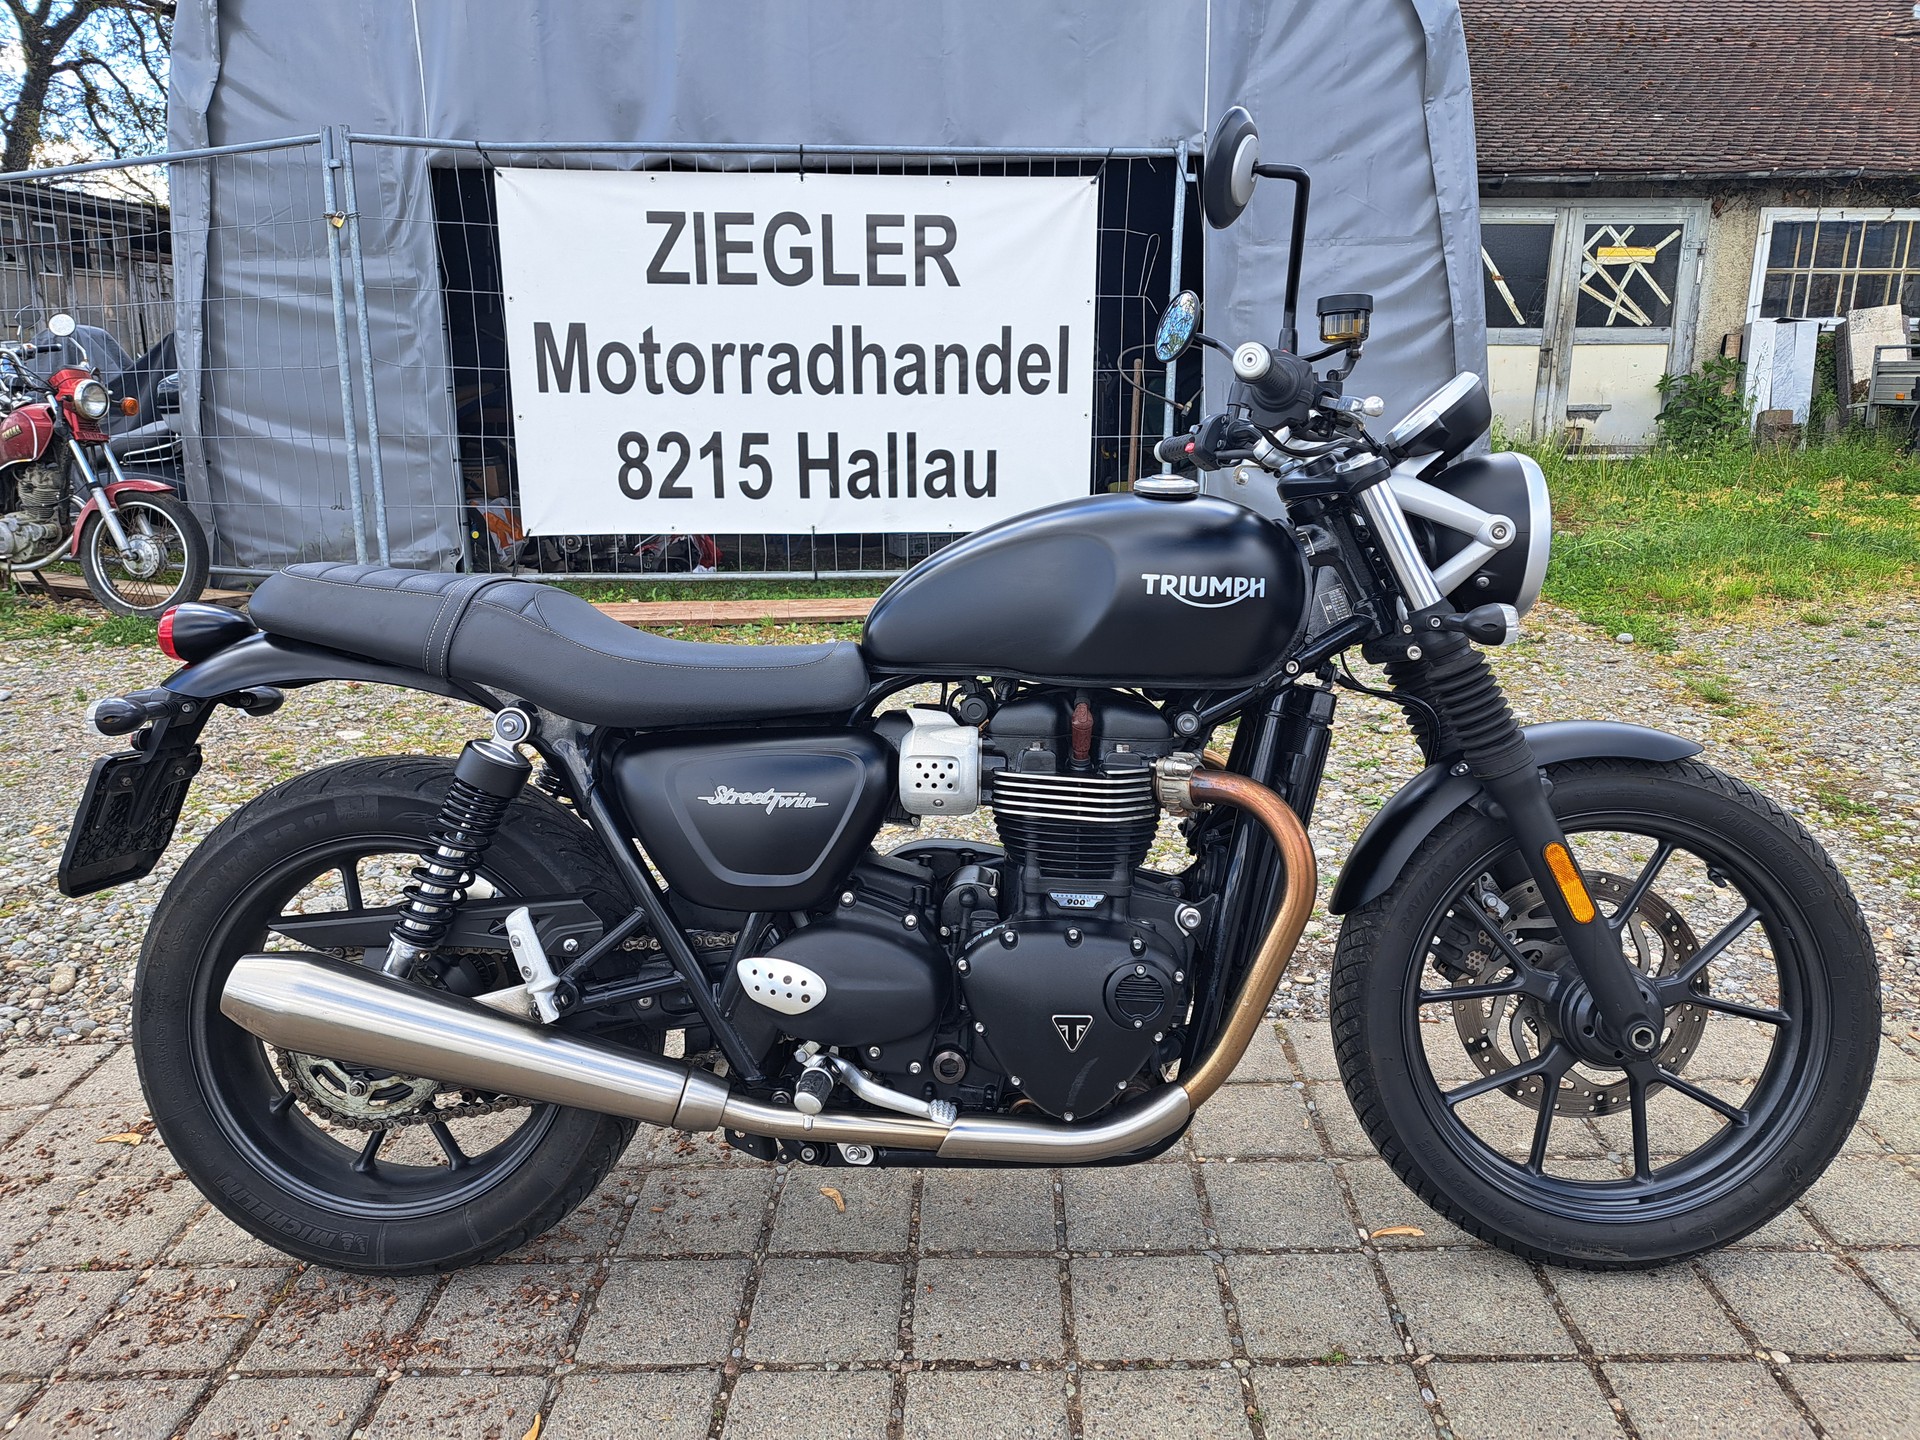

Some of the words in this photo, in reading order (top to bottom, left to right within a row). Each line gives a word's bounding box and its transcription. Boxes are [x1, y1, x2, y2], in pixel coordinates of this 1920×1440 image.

[645, 210, 961, 288] ZIEGLER
[533, 321, 1070, 397] Motorradhandel
[617, 431, 773, 500] 8215
[799, 431, 998, 500] Hallau
[1141, 573, 1266, 608] TRIUMPH
[1720, 809, 1826, 899] BRIDGESTONE
[1066, 898, 1086, 906] 900
[216, 1176, 339, 1248] MICHELIN
